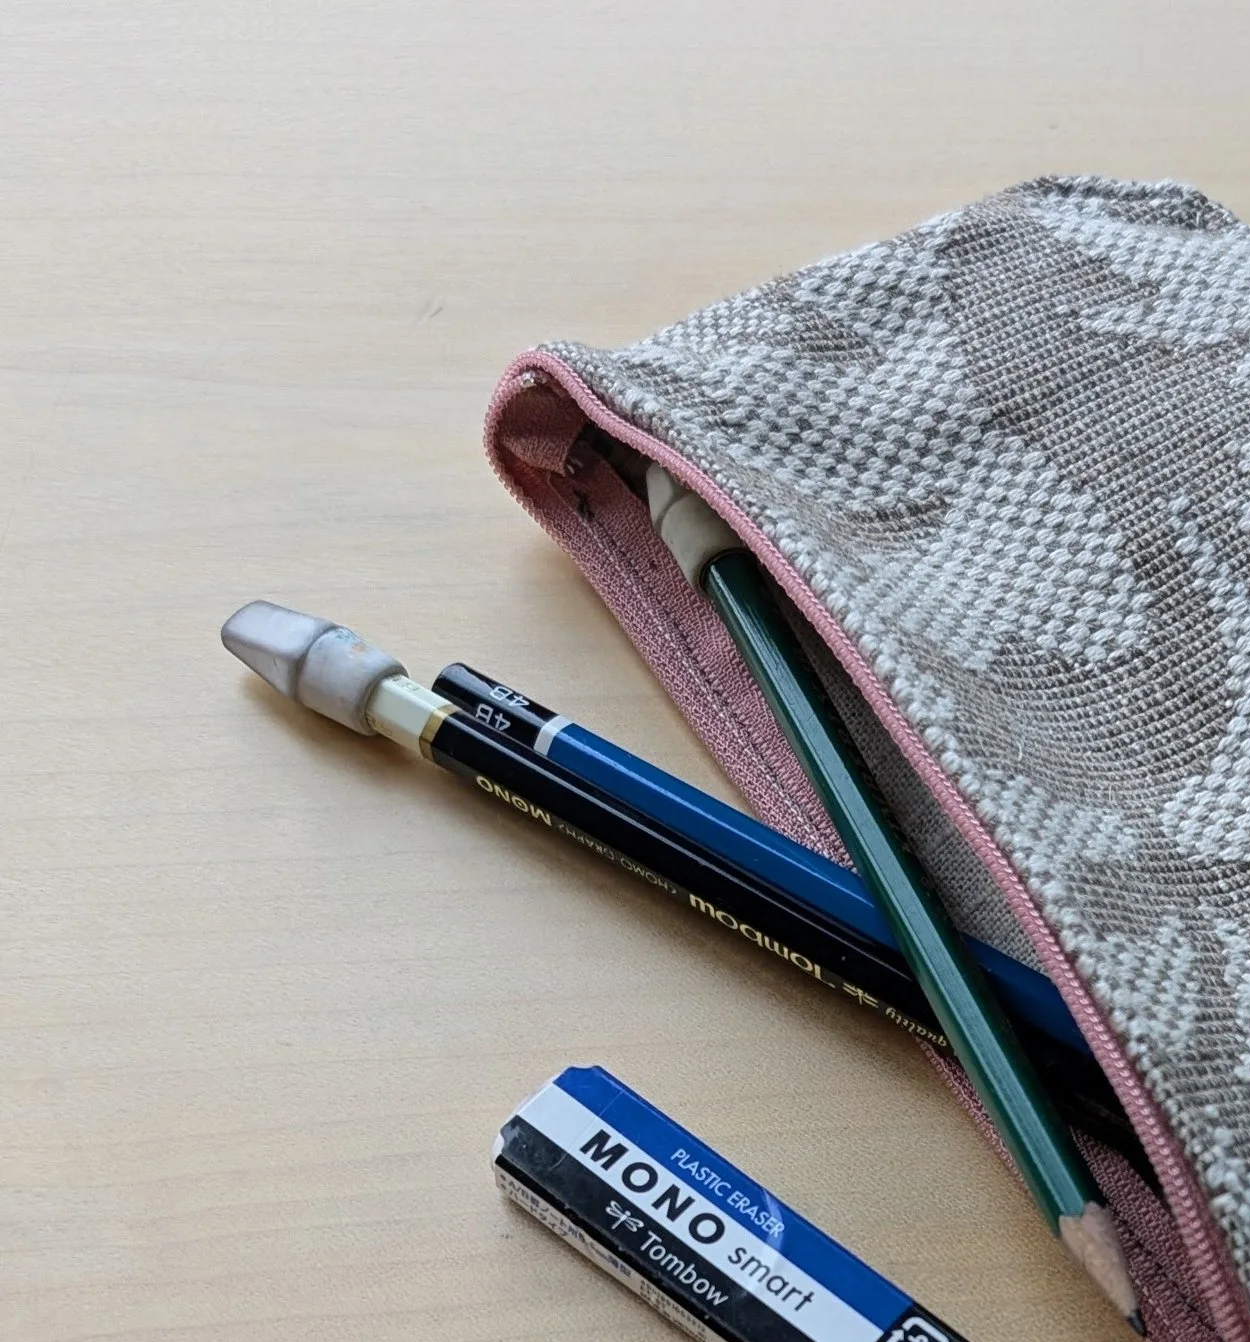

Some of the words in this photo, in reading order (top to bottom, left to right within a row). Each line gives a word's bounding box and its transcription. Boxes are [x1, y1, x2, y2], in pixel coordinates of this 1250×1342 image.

[475, 703, 511, 731] 4B
[489, 686, 530, 707] 4B
[475, 775, 553, 827] MONO
[688, 892, 836, 989] Tombow
[884, 1006, 949, 1049] quality
[579, 1128, 726, 1245] MONO
[727, 1246, 816, 1312] smart
[670, 1148, 732, 1198] PLASTIC
[726, 1190, 786, 1239] ERASER
[639, 1230, 730, 1307] Tombow
